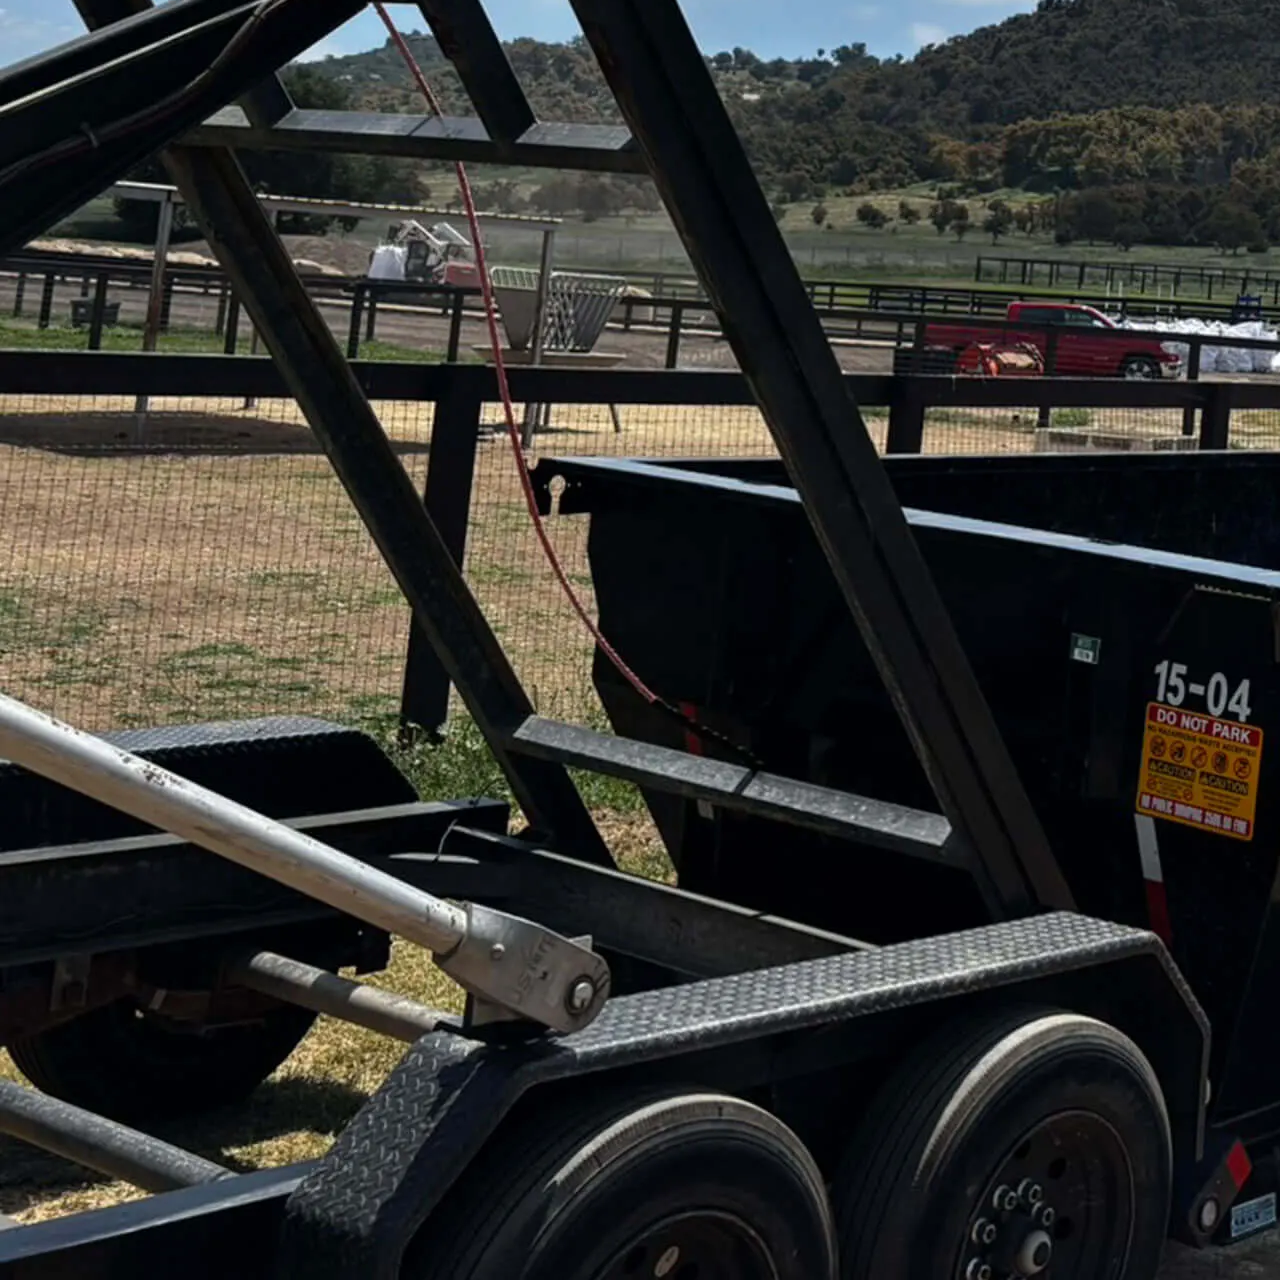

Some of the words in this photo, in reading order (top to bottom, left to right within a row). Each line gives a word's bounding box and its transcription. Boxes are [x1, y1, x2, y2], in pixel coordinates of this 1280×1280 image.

[1153, 660, 1252, 722] 15-04
[1156, 708, 1177, 724] DO
[1180, 715, 1209, 733] NOT
[1212, 723, 1251, 744] PARK
[1208, 775, 1249, 795] CAUTION
